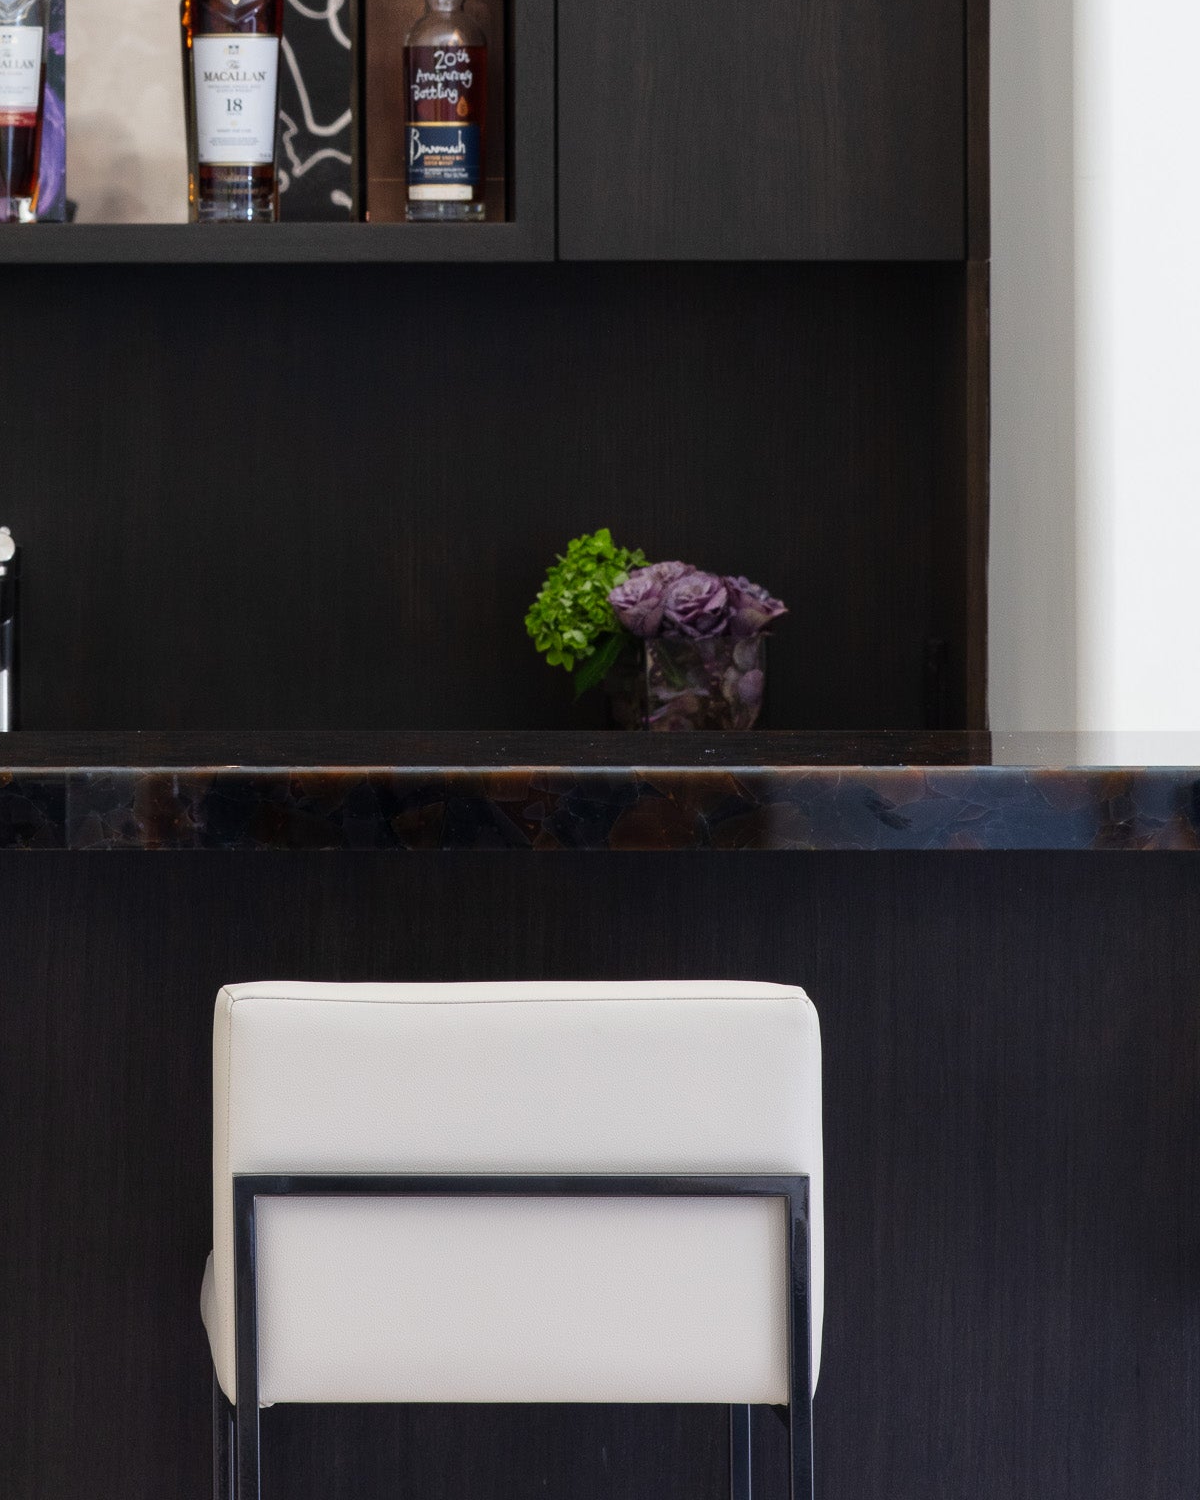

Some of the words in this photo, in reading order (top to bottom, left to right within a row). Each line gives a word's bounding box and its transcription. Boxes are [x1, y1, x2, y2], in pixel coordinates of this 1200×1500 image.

[433, 49, 471, 70] 20th
[203, 71, 267, 82] MACALLAN
[410, 83, 459, 104] Bottling
[226, 98, 243, 112] 18
